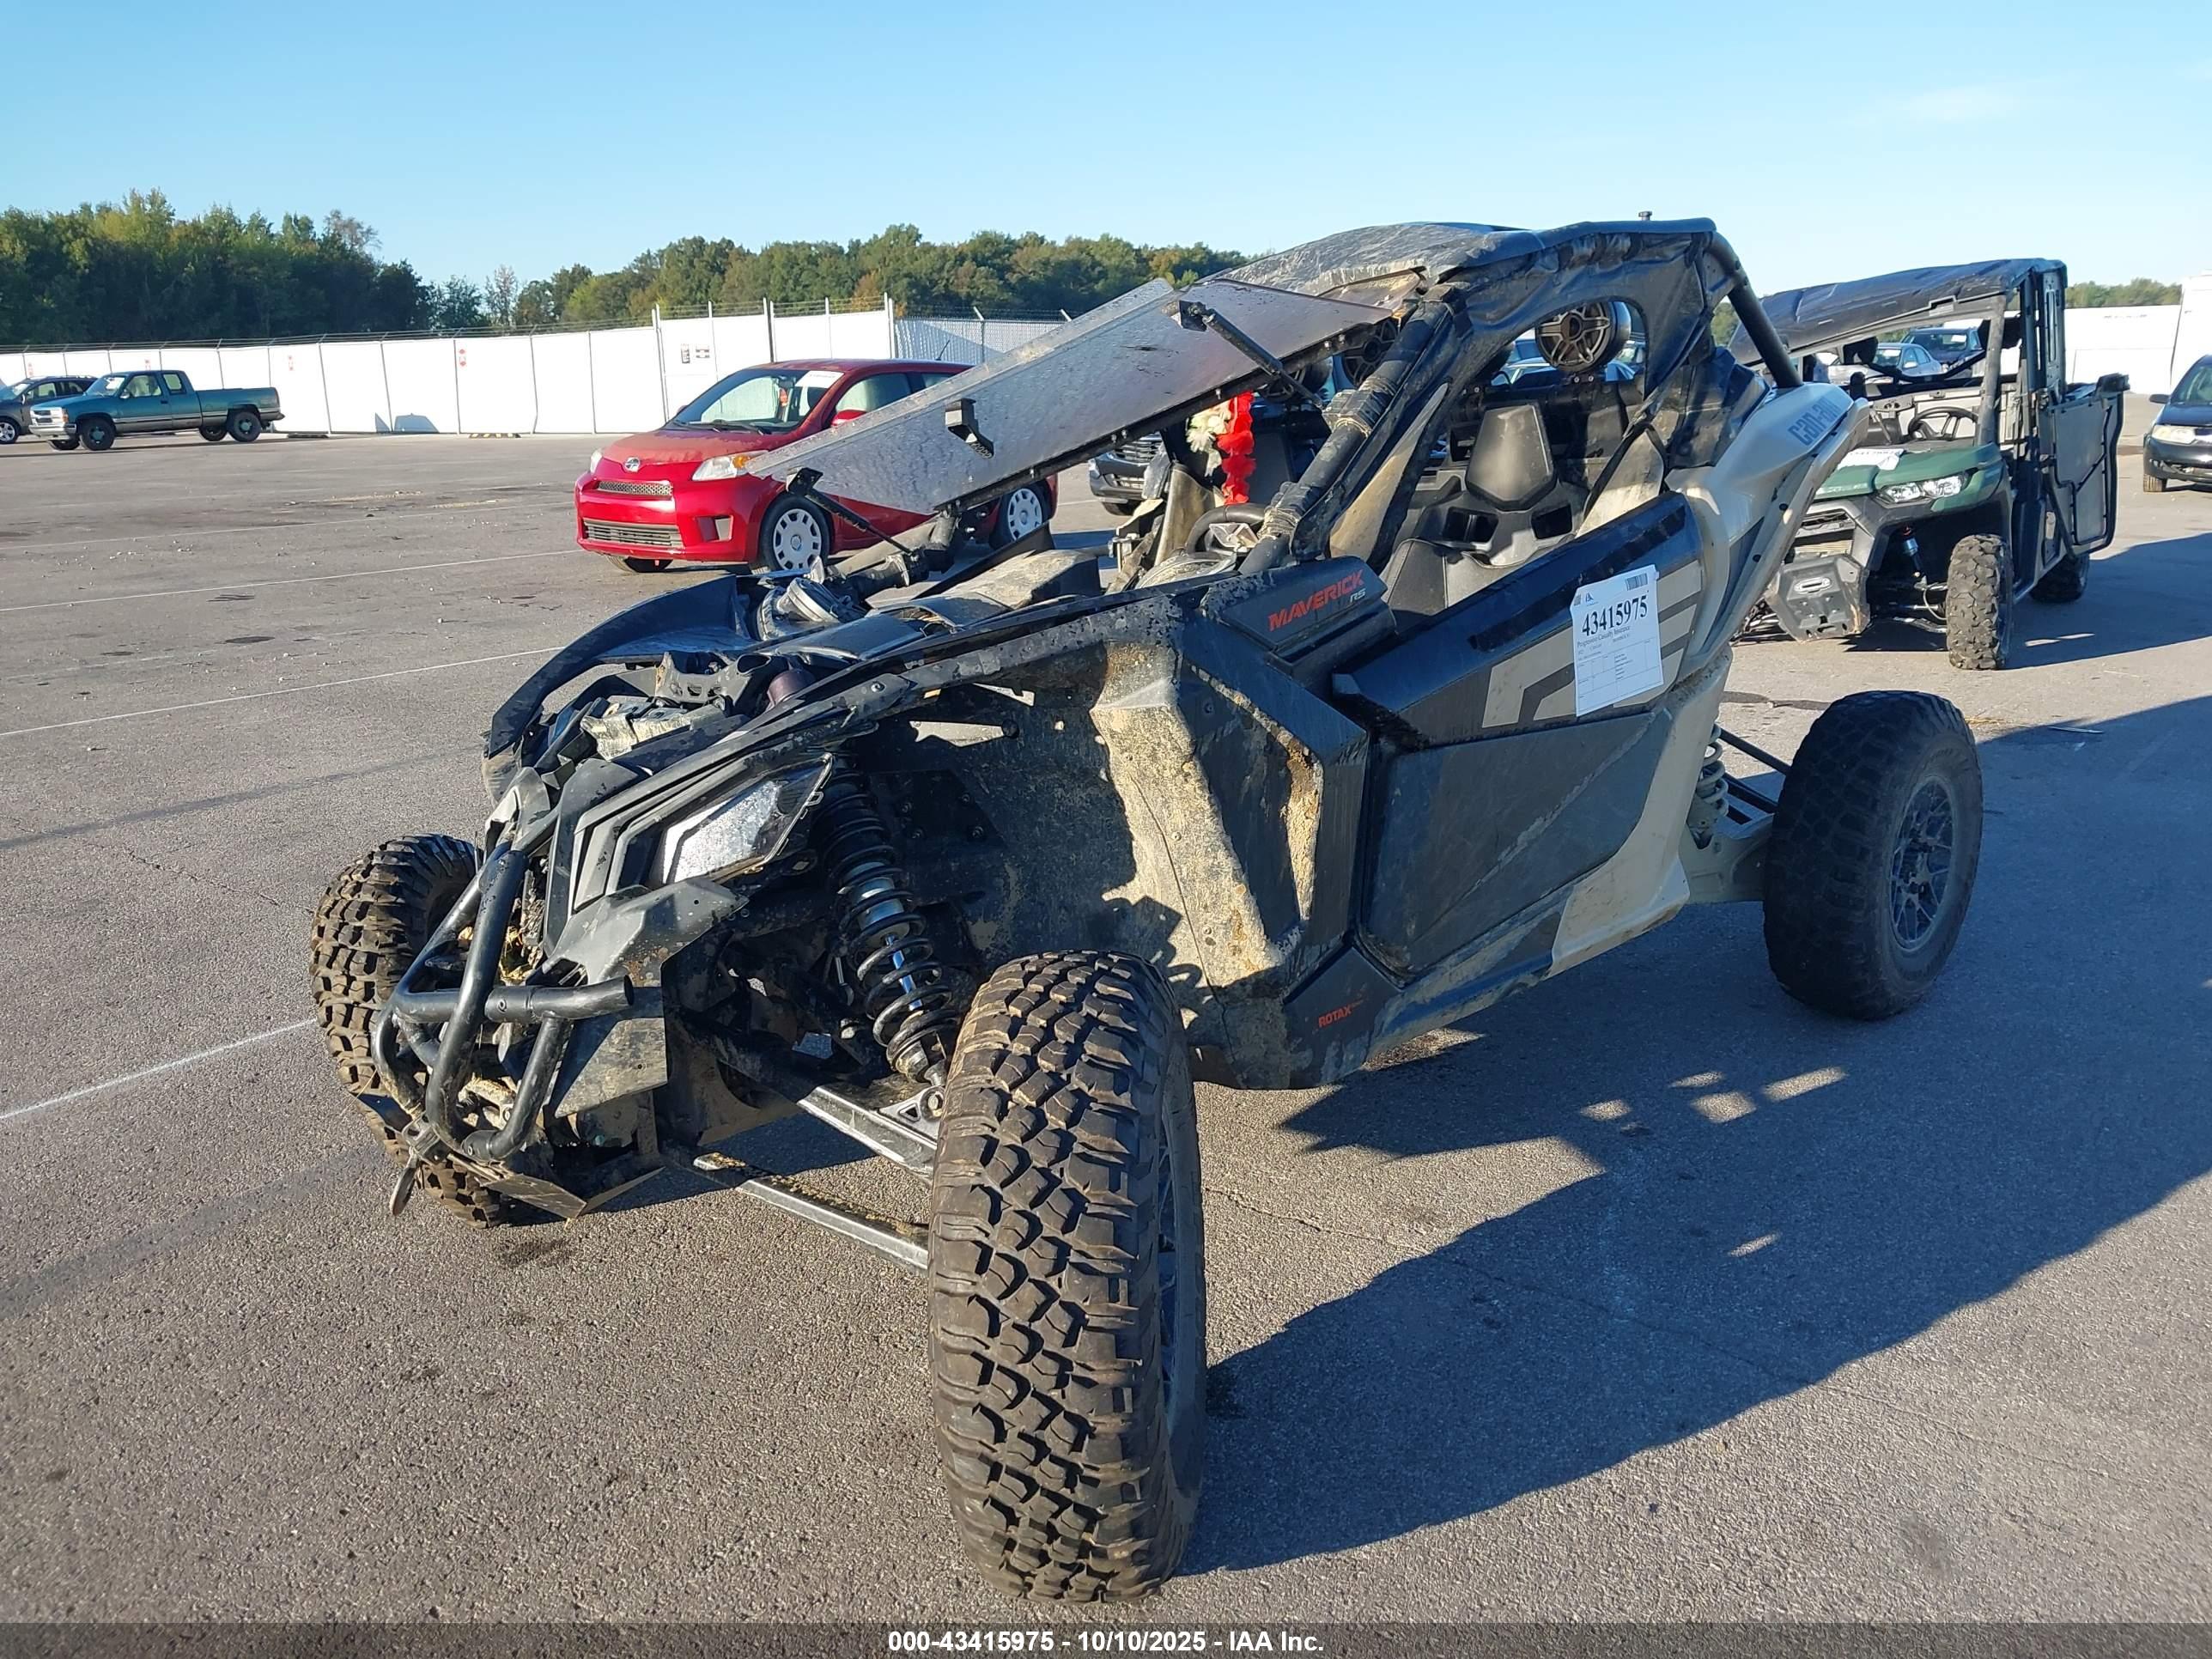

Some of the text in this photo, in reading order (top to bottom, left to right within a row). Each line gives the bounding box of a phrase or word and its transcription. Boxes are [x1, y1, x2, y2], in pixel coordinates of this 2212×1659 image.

[1267, 568, 1364, 632] MAVERICK
[1350, 587, 1366, 603] RS
[1582, 595, 1648, 635] 43415975
[1318, 1006, 1352, 1028] ROTAX
